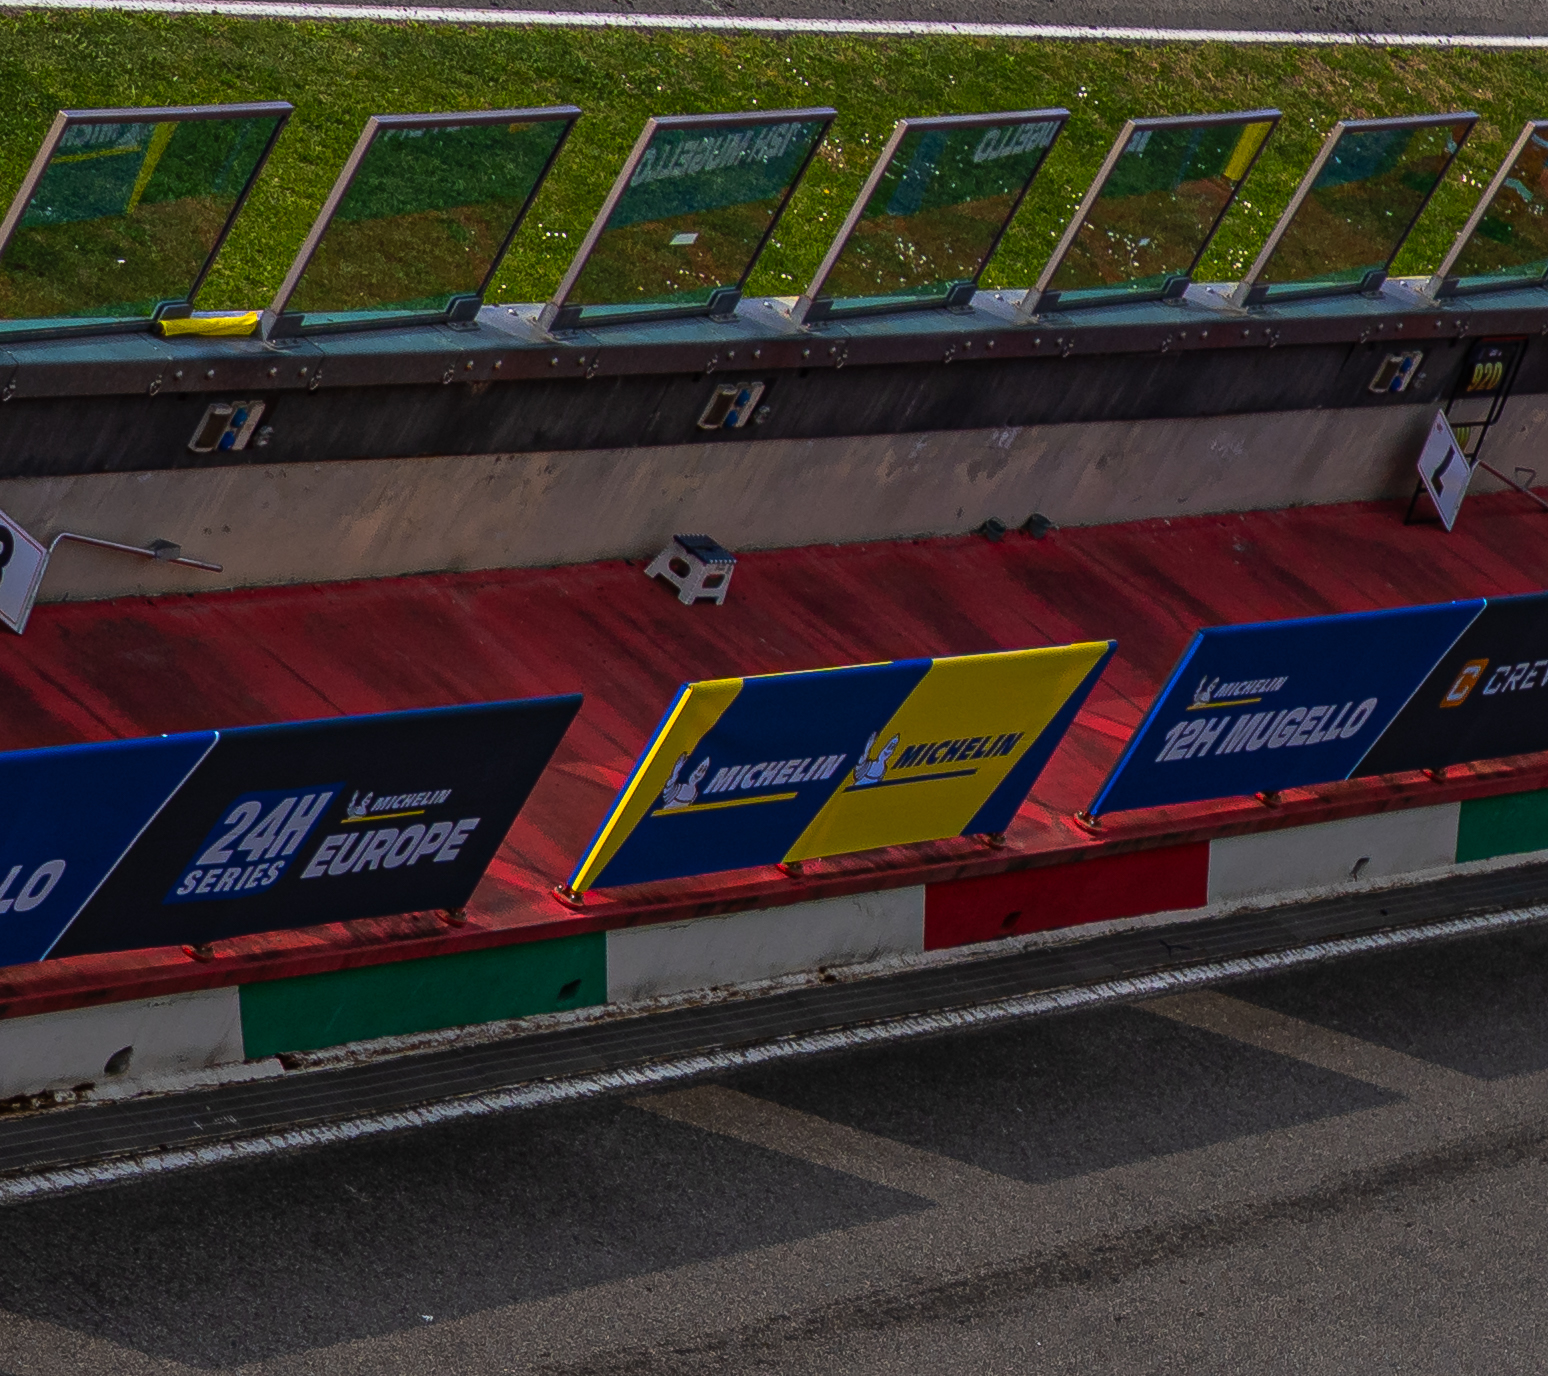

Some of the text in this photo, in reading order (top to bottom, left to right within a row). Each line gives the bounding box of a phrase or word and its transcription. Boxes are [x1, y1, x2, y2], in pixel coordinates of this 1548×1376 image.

[1214, 676, 1289, 699] MICHELIN
[1155, 697, 1378, 763] 12H MUGELLO
[892, 732, 1025, 770] MICHELIN
[704, 754, 847, 795] MICHELIN
[371, 789, 452, 812] MICHELIN
[196, 792, 333, 865] 24H
[301, 818, 481, 880] EUROPE
[177, 860, 286, 896] SERIES
